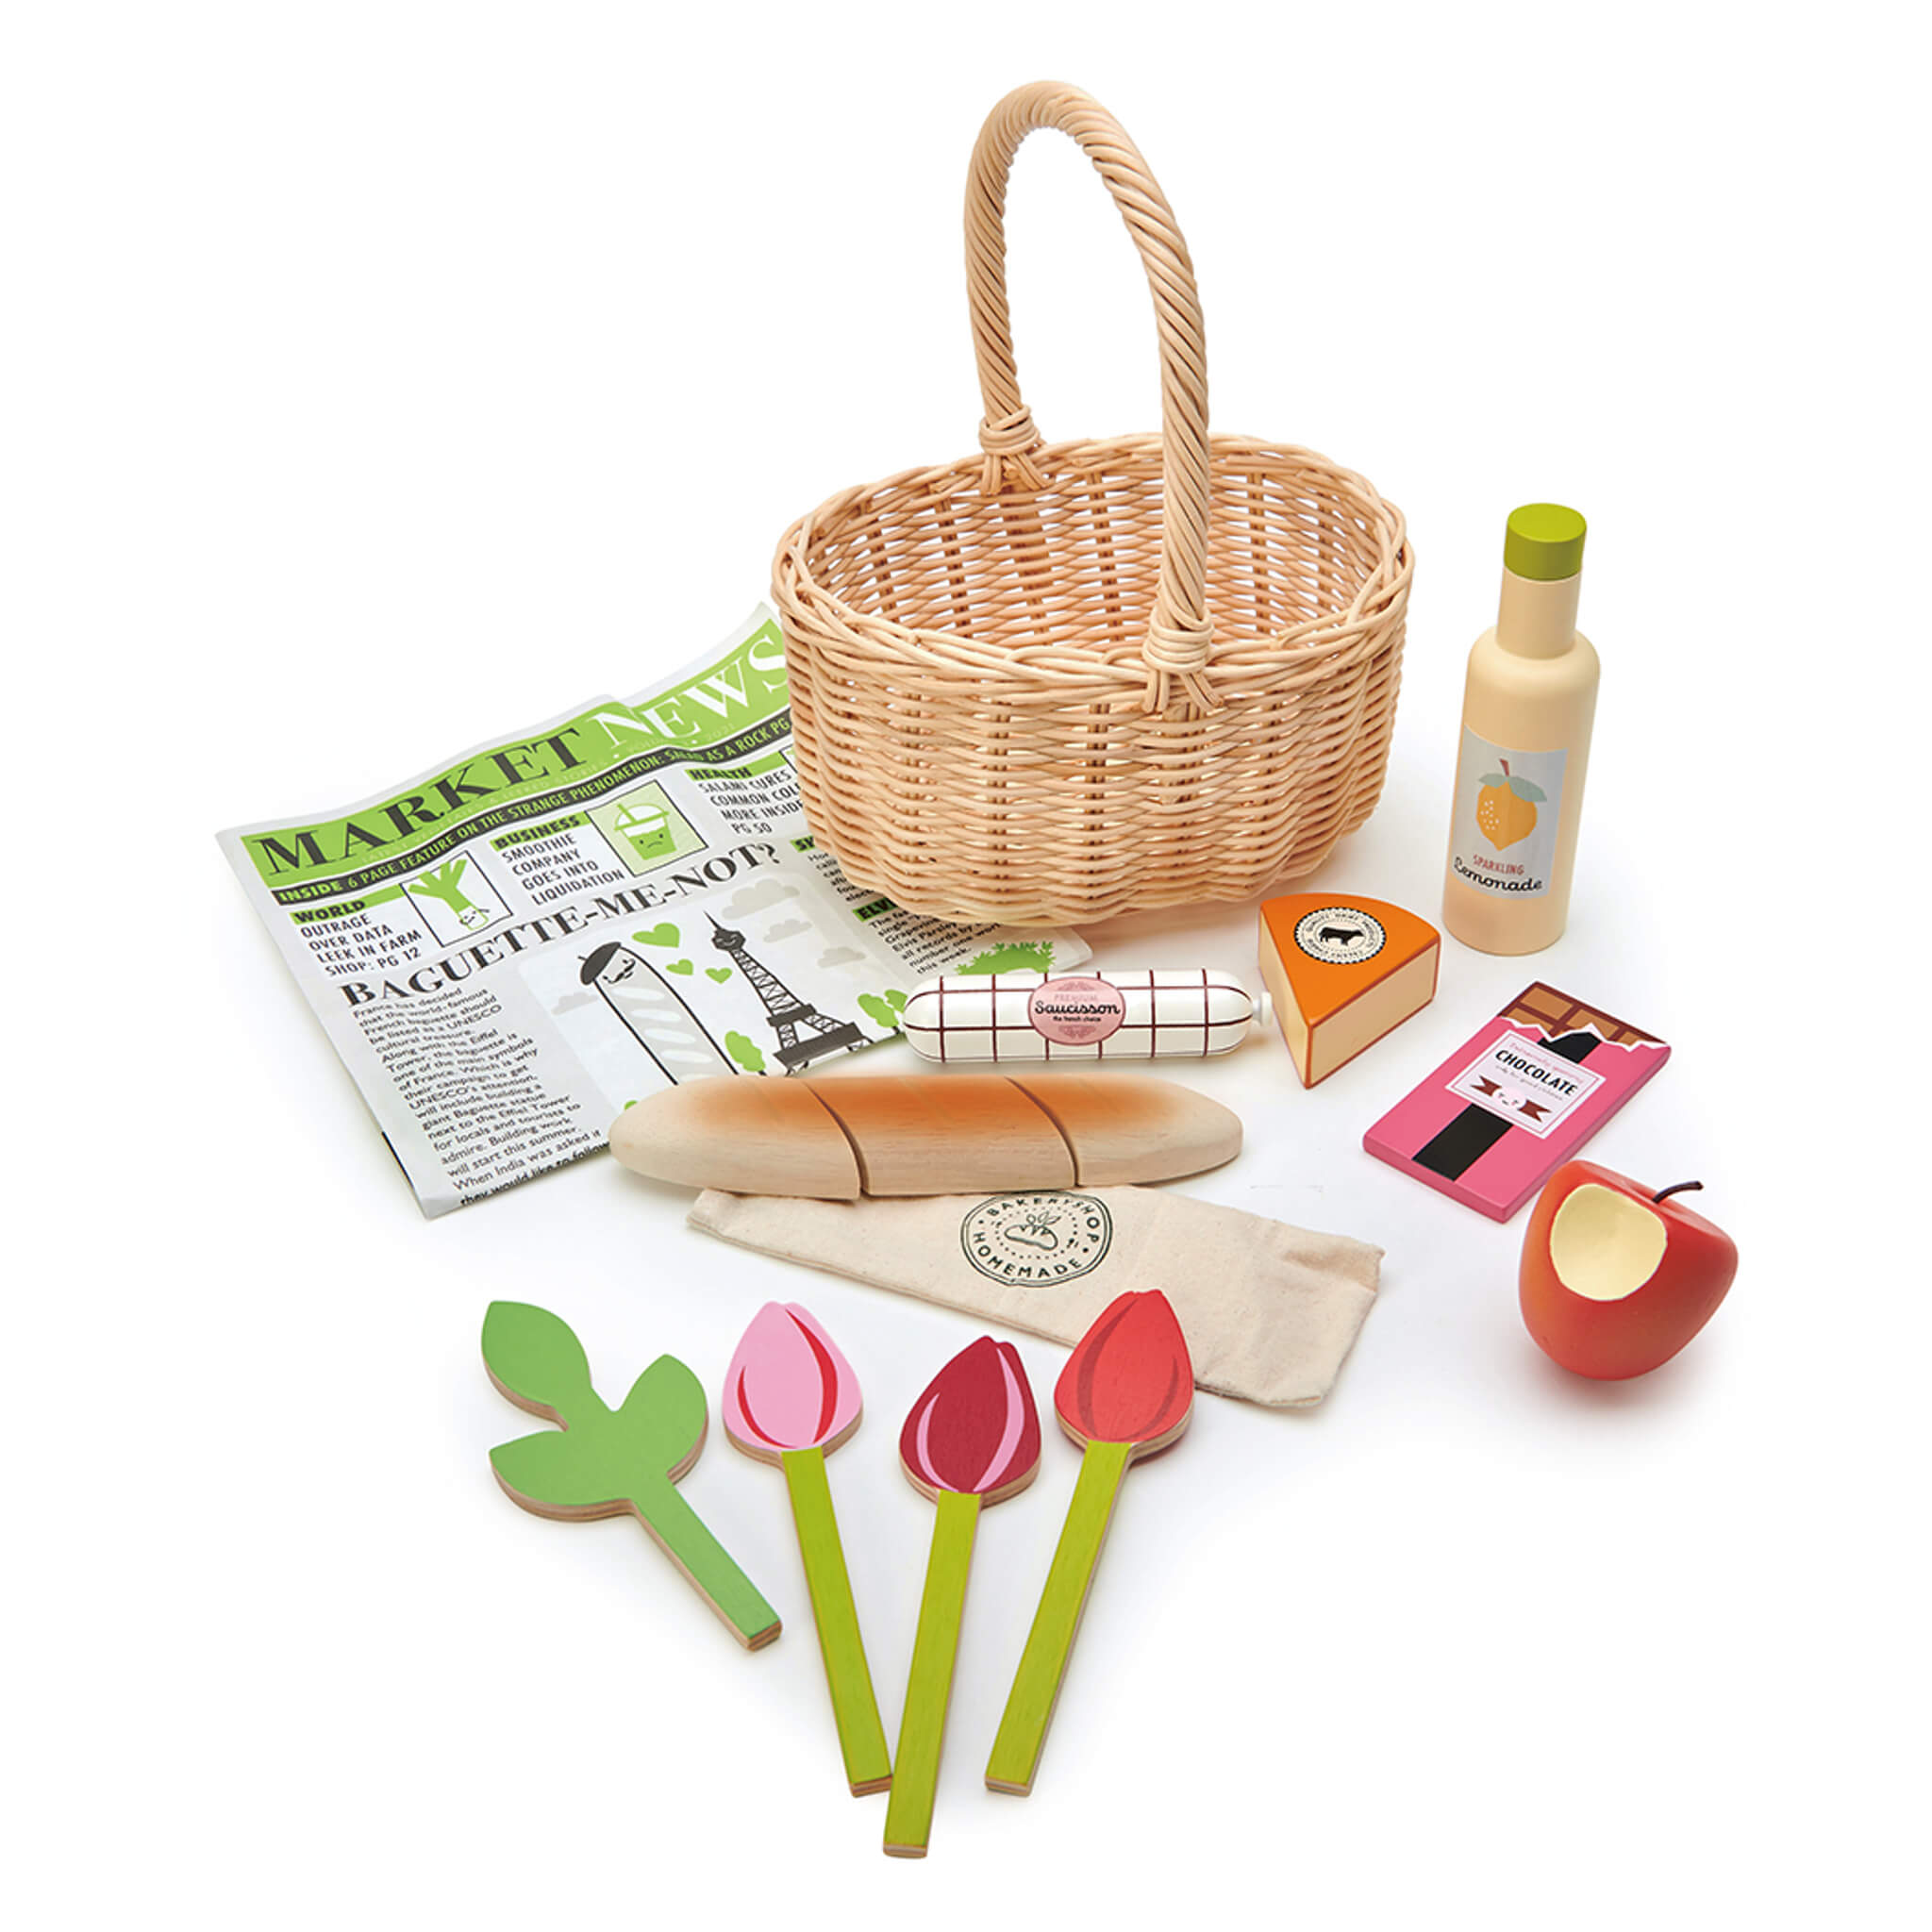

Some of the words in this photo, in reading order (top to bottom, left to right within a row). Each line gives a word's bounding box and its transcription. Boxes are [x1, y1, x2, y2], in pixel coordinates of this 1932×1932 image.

[252, 727, 587, 875] MARKET
[583, 635, 789, 749] NEWS
[690, 766, 753, 780] HEALTH
[698, 780, 748, 793] SALAMI
[748, 769, 792, 791] CURES
[278, 880, 342, 901] INSIDE
[348, 875, 358, 888] 6
[359, 862, 398, 884] PAGE
[399, 833, 458, 870] FEATURE
[457, 821, 479, 838] ON
[481, 808, 508, 828] THE
[507, 792, 568, 820] STRANGE
[569, 752, 662, 802] PHENOMENON:
[708, 747, 724, 761] AS
[724, 744, 738, 758] A
[736, 724, 772, 752] ROCK
[770, 716, 791, 736] PG
[709, 792, 772, 808] COMMON
[720, 808, 761, 821] MORE
[493, 815, 581, 850] BUSINESS
[730, 822, 753, 835] PG
[501, 832, 577, 864] SMOOTHIE
[511, 848, 581, 877] COMPANY
[521, 869, 562, 891] GOES
[563, 859, 599, 879] INTO
[1454, 856, 1542, 891] Lemonade
[1473, 854, 1525, 876] SPARKLING
[531, 869, 625, 907] LIQUIDATION
[294, 900, 366, 923] WORLD
[300, 913, 372, 939] OUTRAGE
[339, 842, 781, 1008] BAGUETTE-ME-NOT?
[869, 917, 892, 929] The
[308, 936, 350, 952] OVER
[353, 924, 393, 943] DATA
[316, 948, 356, 964] LEEK
[358, 944, 377, 958] IN
[379, 929, 423, 953] FARM
[376, 955, 400, 969] PG
[402, 946, 422, 961] 12
[908, 946, 949, 966] number
[916, 962, 939, 974] this
[353, 1003, 393, 1019] France
[394, 1002, 415, 1010] has
[418, 987, 462, 1007] decided
[359, 1014, 383, 1028] that
[385, 1010, 405, 1019] the
[364, 1019, 406, 1036] French
[407, 1012, 458, 1026] baguette
[459, 994, 497, 1015] should
[1035, 1000, 1121, 1014] Saucisson
[369, 1036, 385, 1045] be
[387, 1026, 420, 1039] listed
[446, 1004, 502, 1030] UNESCO
[375, 1036, 420, 1054] cultural
[382, 1048, 418, 1064] Along
[419, 1041, 446, 1052] with
[470, 1027, 499, 1044] Eiffel
[455, 1039, 506, 1056] baguette
[507, 1032, 518, 1041] is
[392, 1070, 416, 1083] one
[418, 1062, 432, 1073] of
[433, 1059, 455, 1068] the
[457, 1057, 486, 1065] main
[488, 1038, 534, 1061] symbols
[398, 1080, 411, 1091] of
[459, 1063, 500, 1074] Which
[501, 1058, 512, 1068] is
[514, 1047, 539, 1062] why
[1495, 1049, 1579, 1097] CHOCOLATE
[404, 1085, 433, 1102] their
[436, 1074, 491, 1090] campaign
[509, 1063, 528, 1077] get
[415, 1106, 439, 1120] will
[439, 1095, 483, 1111] include
[422, 1114, 452, 1132] giant
[453, 1102, 508, 1119] Baguette
[509, 1092, 546, 1107] statue
[427, 1124, 457, 1141] next
[458, 1120, 474, 1129] to
[475, 1113, 497, 1124] the
[498, 1106, 528, 1119] Eiffel
[528, 1095, 571, 1111] Tower
[433, 1140, 452, 1153] for
[455, 1125, 491, 1144] locals
[493, 1119, 516, 1131] and
[518, 1108, 565, 1124] tourists
[566, 1103, 581, 1112] to
[488, 1124, 539, 1146] Building
[540, 1117, 573, 1130] work
[447, 1161, 471, 1178] will
[472, 1151, 502, 1170] start
[503, 1141, 527, 1157] this
[453, 1171, 494, 1191] When
[494, 1159, 526, 1176] India
[527, 1147, 554, 1163] was
[556, 1132, 591, 1153] asked
[973, 1231, 1082, 1278] HOMEMADE
